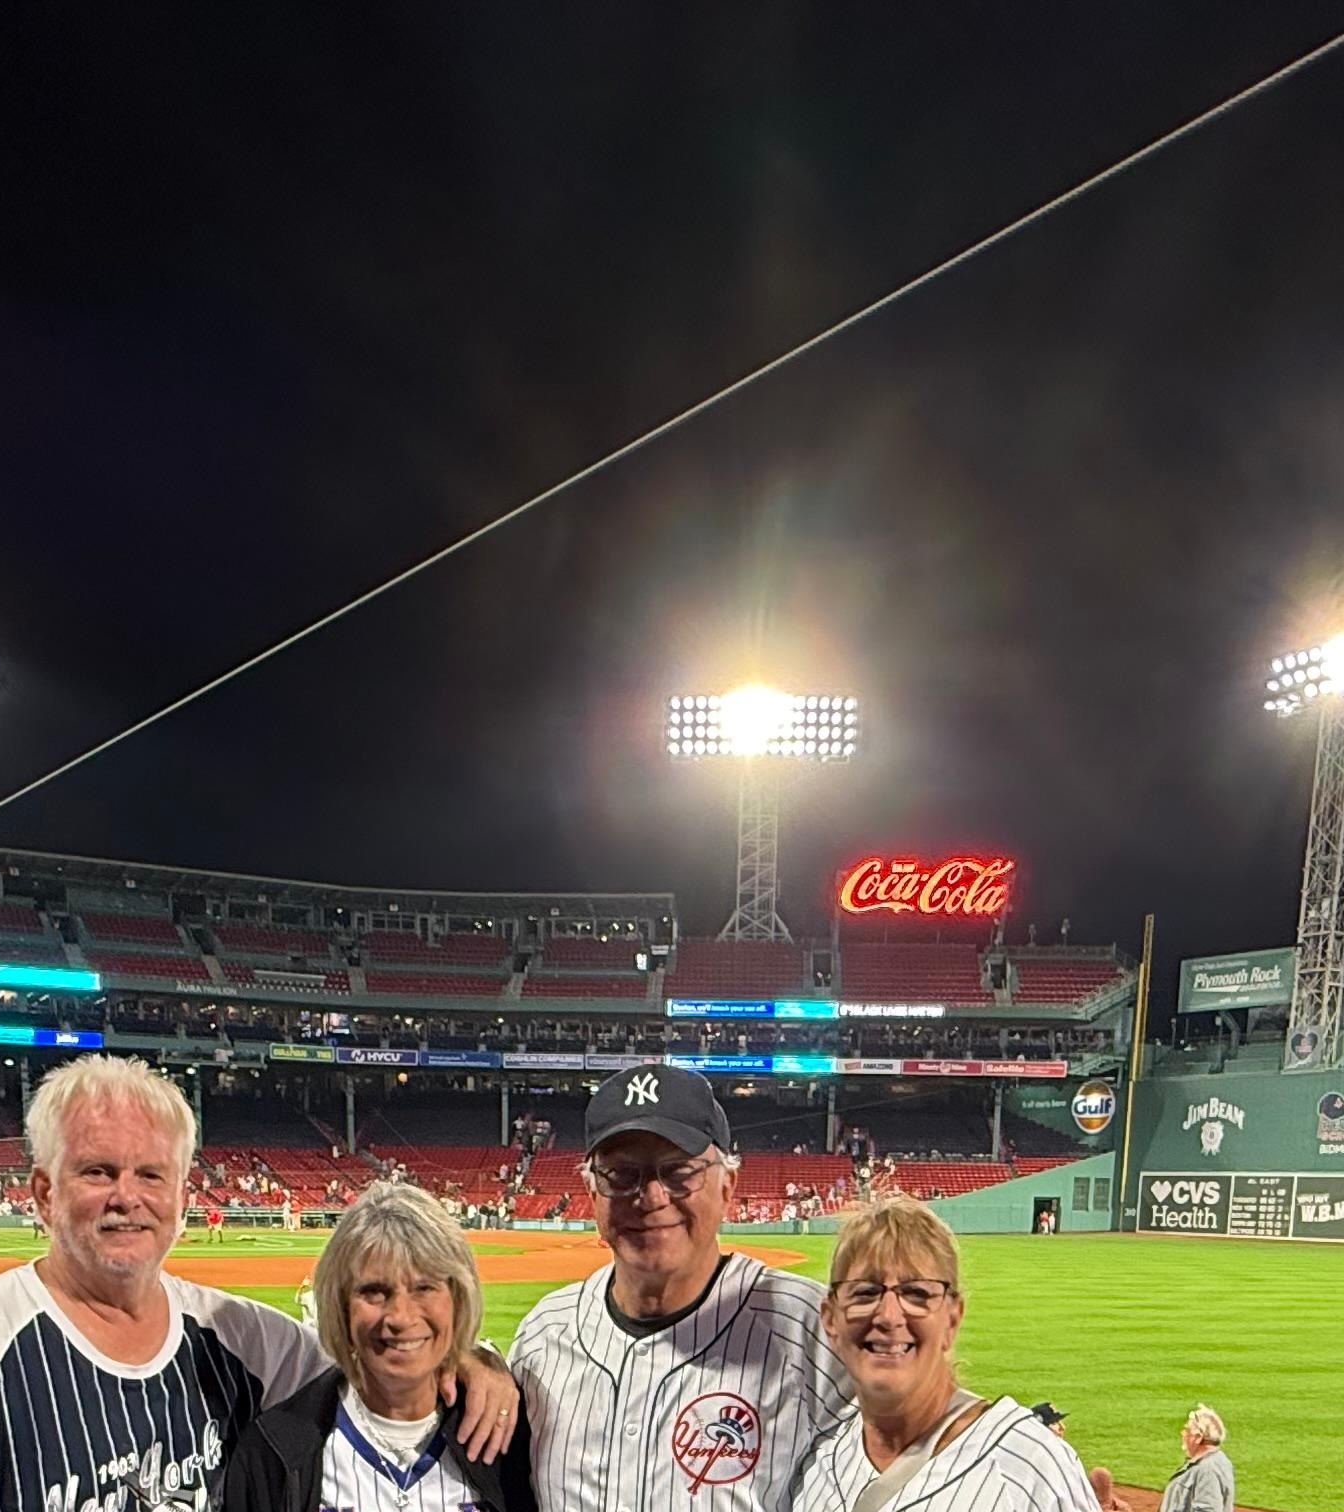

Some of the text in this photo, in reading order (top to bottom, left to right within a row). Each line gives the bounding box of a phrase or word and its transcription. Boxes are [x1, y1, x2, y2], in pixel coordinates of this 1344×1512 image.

[1193, 968, 1249, 989] Plymouth
[1250, 965, 1282, 983] Rock
[367, 1052, 401, 1062] HYCU
[624, 1072, 660, 1106] NY
[1074, 1097, 1113, 1115] Gulf
[1182, 1097, 1246, 1131] JIM BEAM
[1172, 1180, 1220, 1205] CVS
[1150, 1205, 1218, 1229] Health
[675, 1420, 761, 1460] Yankees
[98, 1452, 140, 1485] 1903
